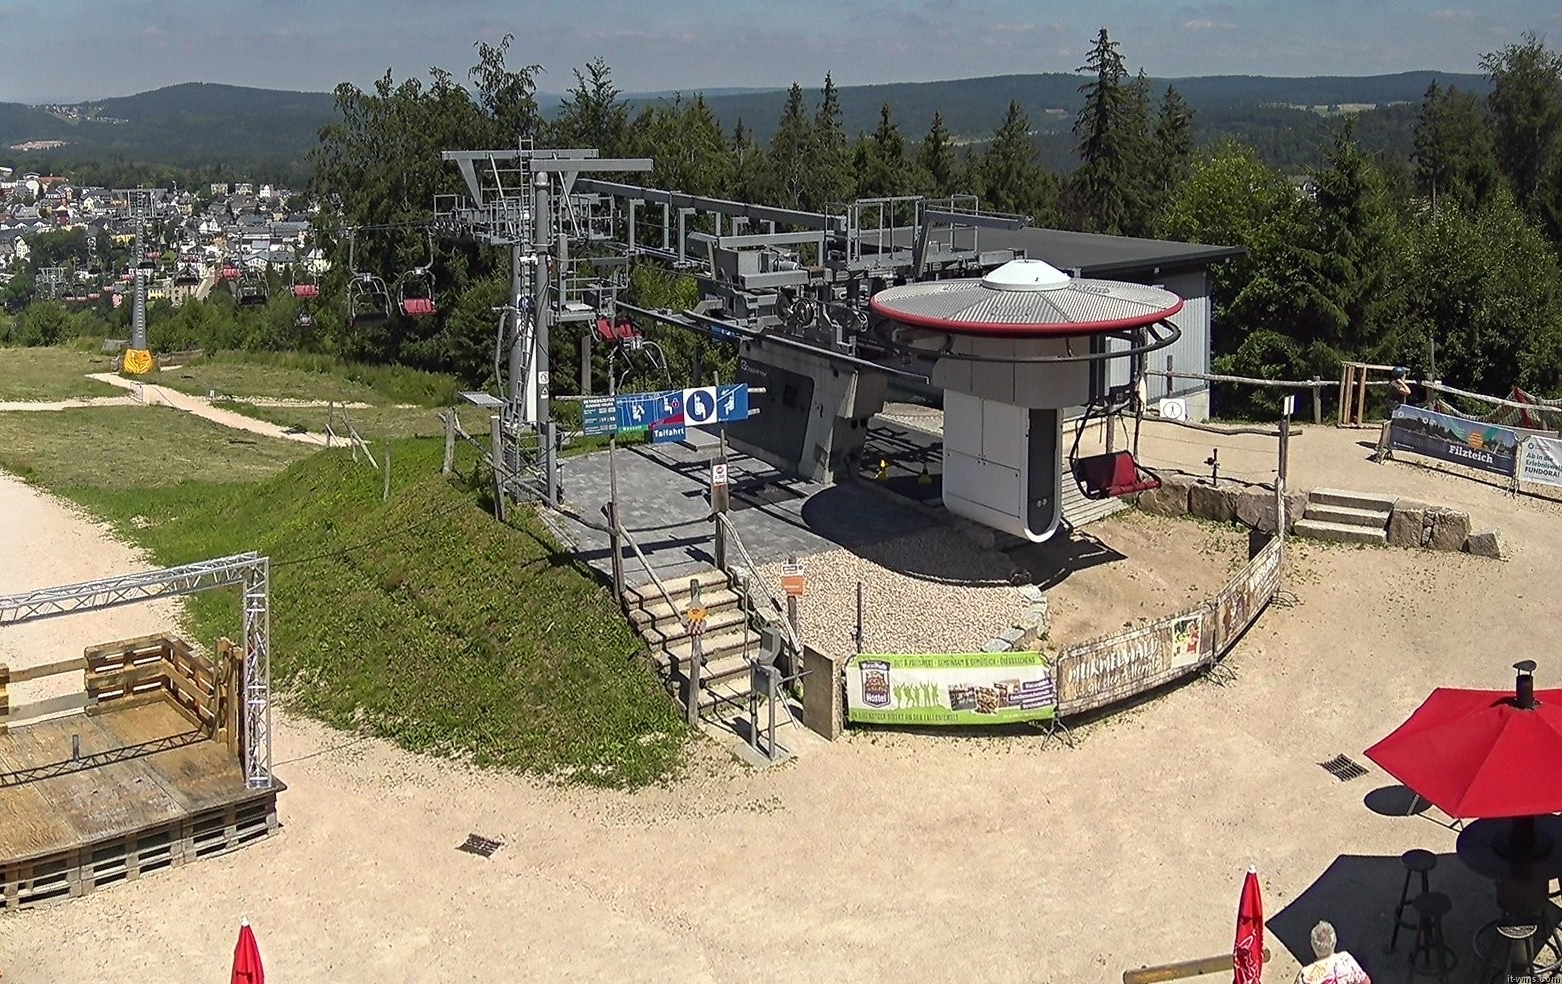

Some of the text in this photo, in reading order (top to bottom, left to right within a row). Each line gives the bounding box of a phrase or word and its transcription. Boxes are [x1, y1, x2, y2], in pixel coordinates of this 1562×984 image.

[653, 427, 685, 438] Talfahrt
[1448, 444, 1494, 464] Filzteich
[1524, 466, 1561, 478] FUNDORA!
[865, 692, 887, 703] Hostel
